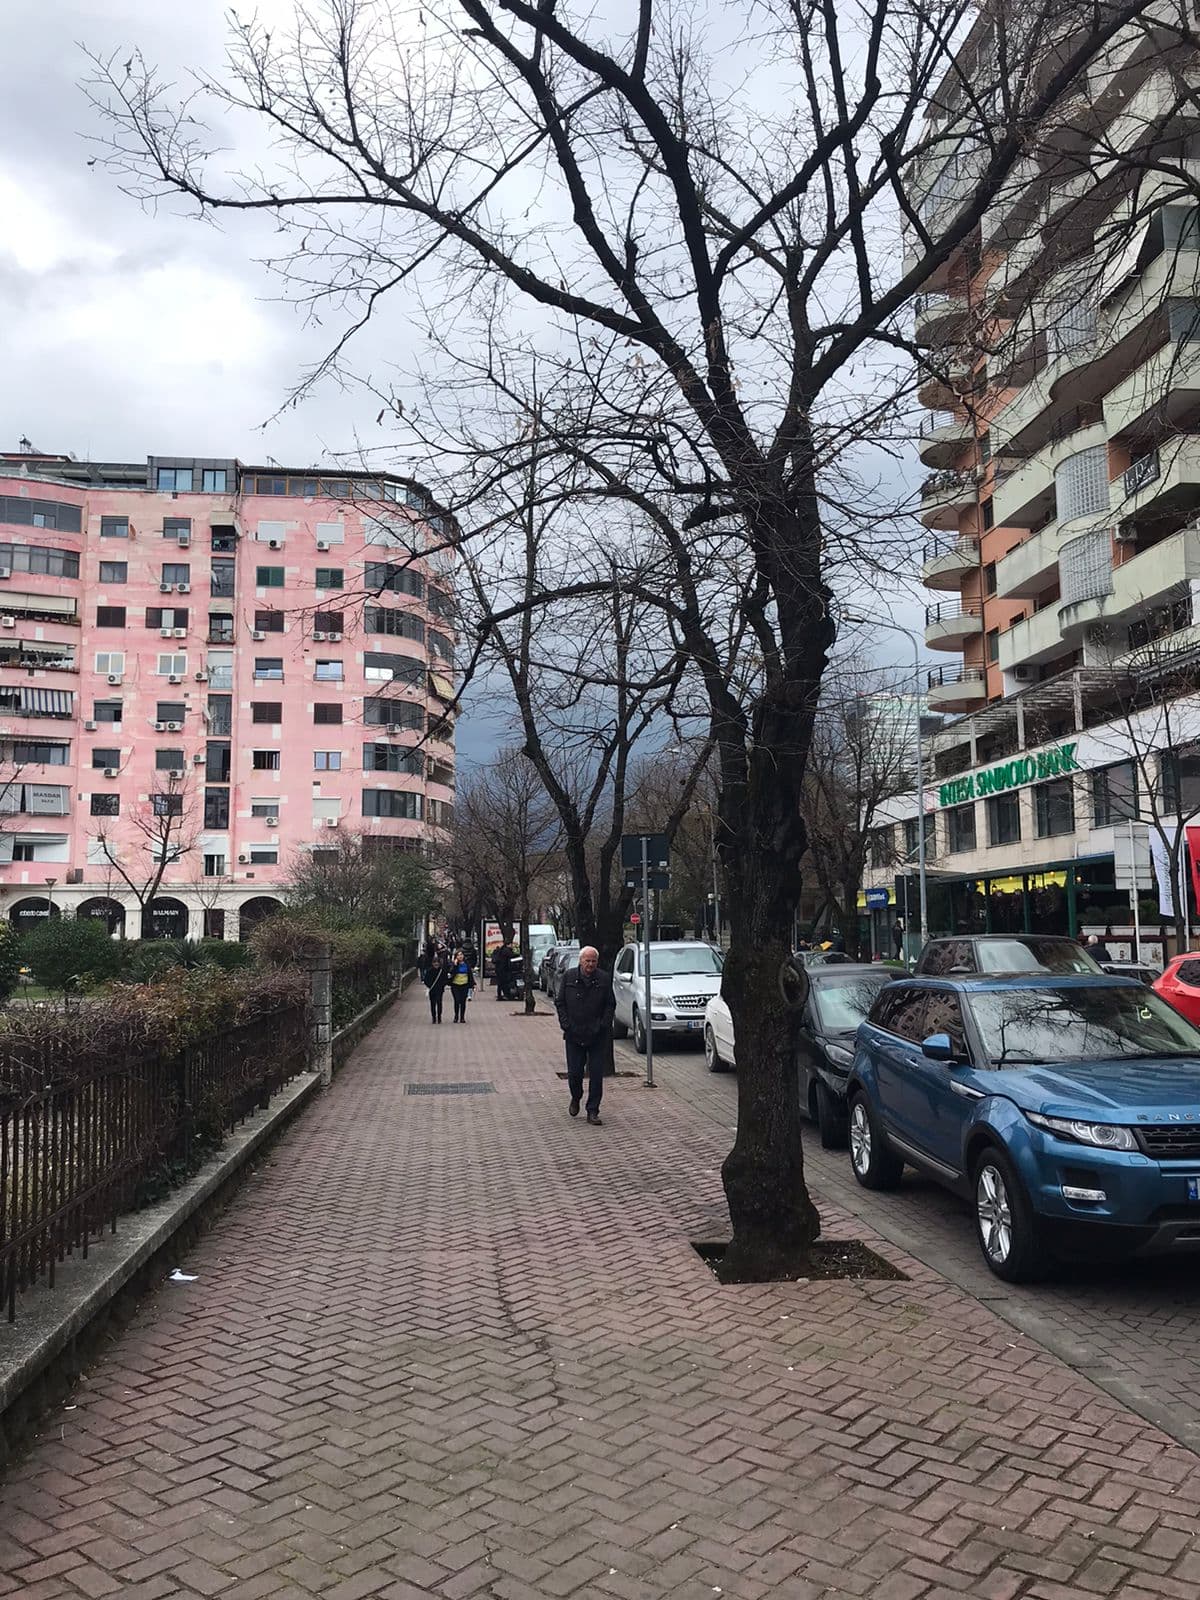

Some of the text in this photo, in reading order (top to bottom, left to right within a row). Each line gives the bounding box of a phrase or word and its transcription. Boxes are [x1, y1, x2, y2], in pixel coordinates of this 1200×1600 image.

[940, 743, 1078, 806] INTESA SANPAOLO BANK
[1137, 1113, 1200, 1121] RANG
